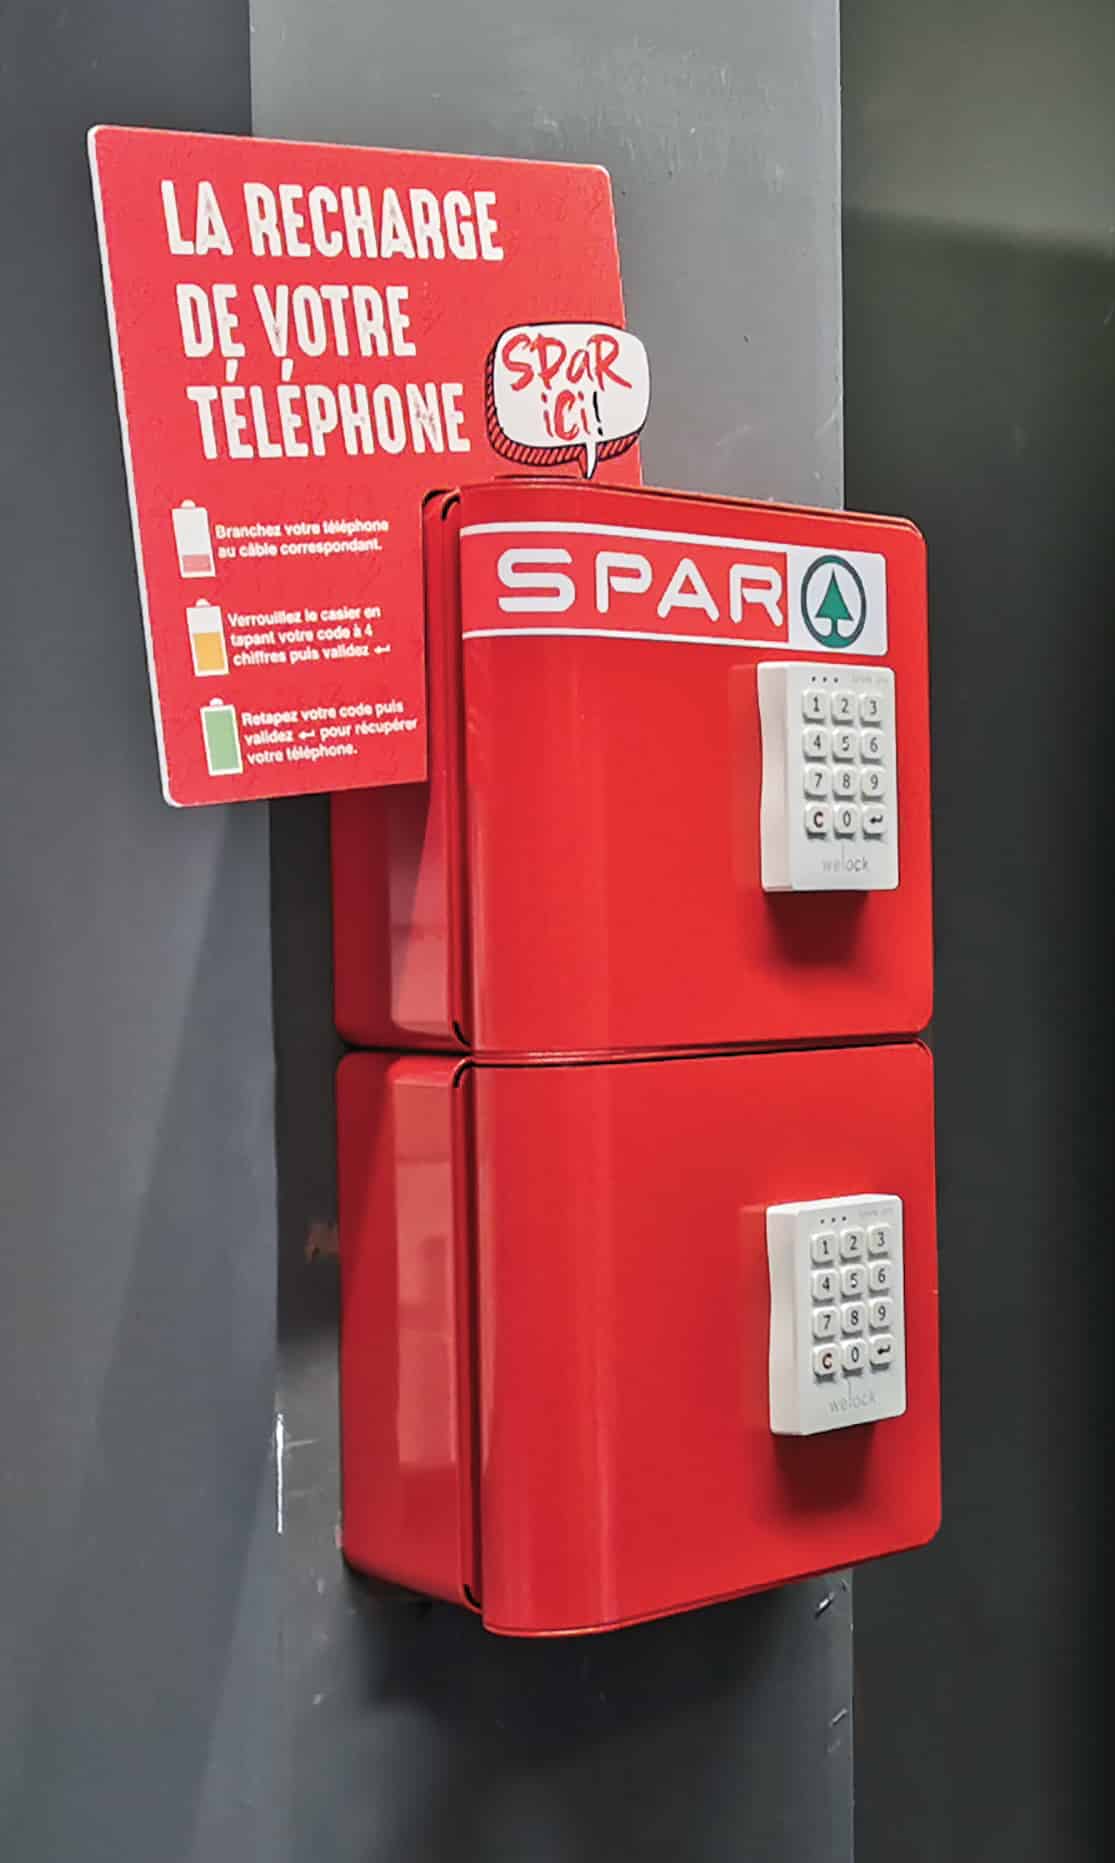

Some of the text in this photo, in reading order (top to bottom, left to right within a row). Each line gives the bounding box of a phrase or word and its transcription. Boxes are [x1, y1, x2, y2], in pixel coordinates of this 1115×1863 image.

[161, 180, 504, 261] LA RECHARGE
[176, 283, 417, 357] DE VOTRE
[186, 358, 471, 460] TÉLÉPHONE
[215, 518, 389, 540] Branchez votre téléphone
[218, 538, 383, 559] au câble correspondant.
[497, 548, 784, 637] SPAR
[227, 607, 381, 628] Verrouillez le casier en
[230, 624, 373, 650] tapant votre code à 4
[233, 643, 369, 667] chiffres puis validez
[241, 700, 404, 728] Retapez votre code puis
[812, 697, 877, 716] 1 2 3
[244, 718, 418, 746] validez pour récupérer
[813, 735, 878, 753] 4 5 6
[247, 742, 359, 765] votre téléphone.
[815, 773, 879, 790] 7 8 9
[813, 810, 851, 828] C 0
[822, 847, 869, 873] welock
[822, 1232, 885, 1256] 1 2 3
[822, 1268, 886, 1291] 4 5 6
[823, 1306, 886, 1330] 7 8 9
[822, 1347, 860, 1370] C 0
[828, 1384, 877, 1414] welock
